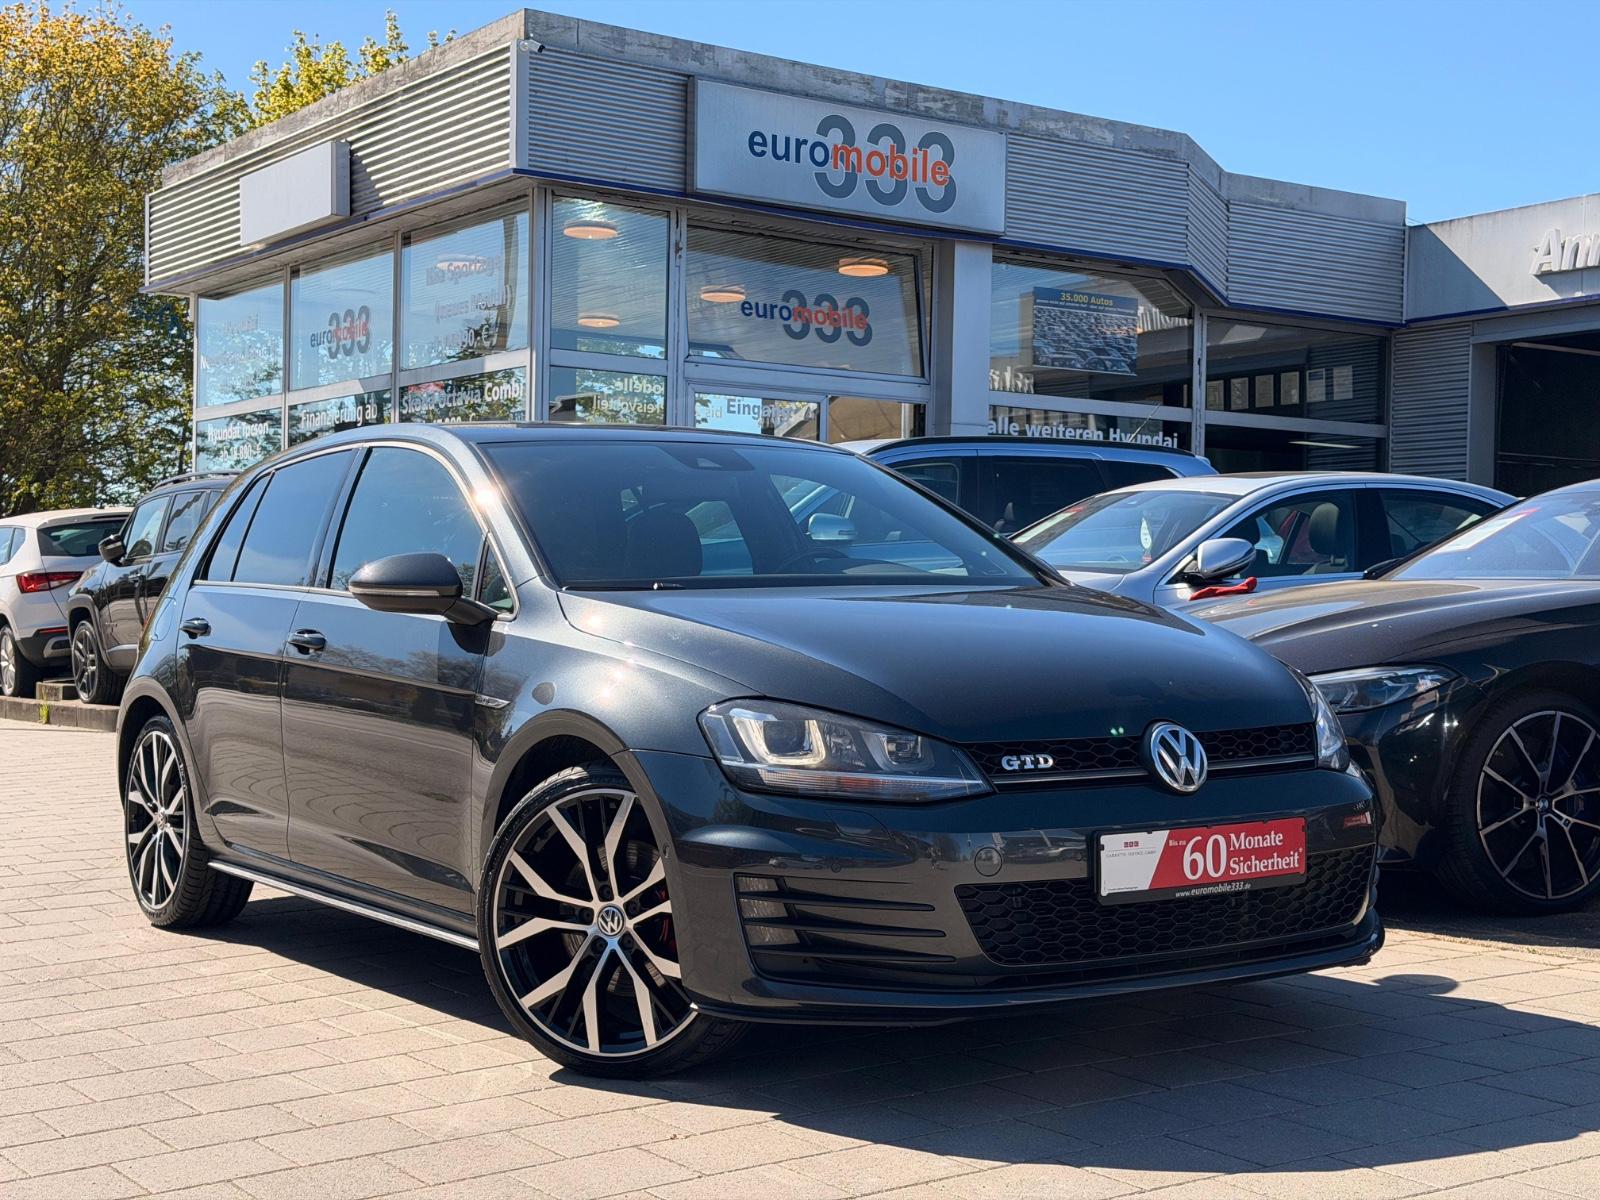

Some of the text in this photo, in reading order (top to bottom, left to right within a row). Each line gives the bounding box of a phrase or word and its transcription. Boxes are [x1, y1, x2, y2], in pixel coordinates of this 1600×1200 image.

[748, 114, 957, 214] euromobile 333
[1061, 293, 1088, 303] 35.000
[1090, 297, 1113, 307] Autos
[741, 290, 873, 346] euromobile 333
[484, 379, 524, 401] Combi
[988, 417, 1020, 437] alle
[1025, 423, 1104, 441] weiteren
[1001, 753, 1054, 770] GTD
[1183, 830, 1283, 880] 60 Monate
[1175, 882, 1251, 897] www.euromobile333.de
